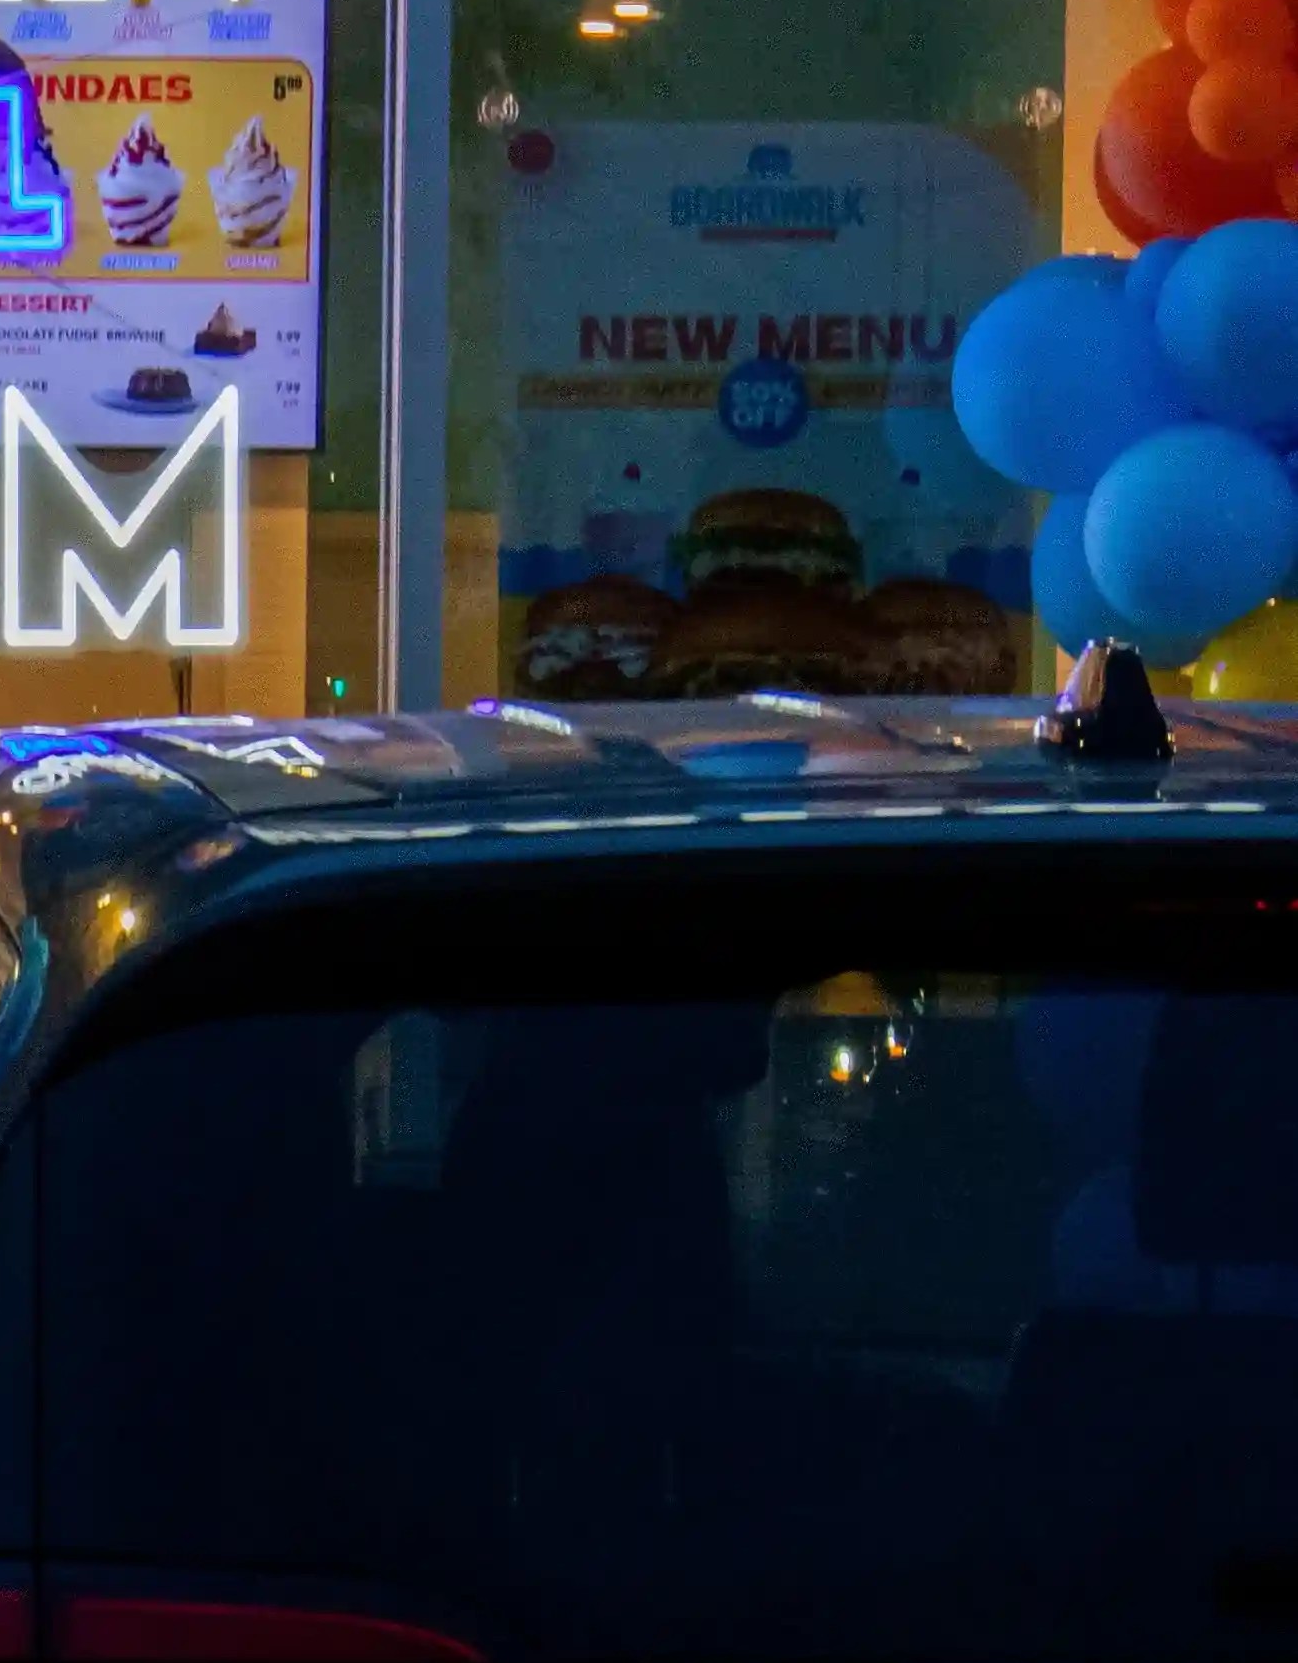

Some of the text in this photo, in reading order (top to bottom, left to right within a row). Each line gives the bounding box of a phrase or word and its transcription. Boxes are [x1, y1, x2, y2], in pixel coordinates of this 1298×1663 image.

[57, 328, 100, 342] FUDGE
[105, 329, 166, 343] BROWNIE
[578, 313, 957, 361] NEW MENU
